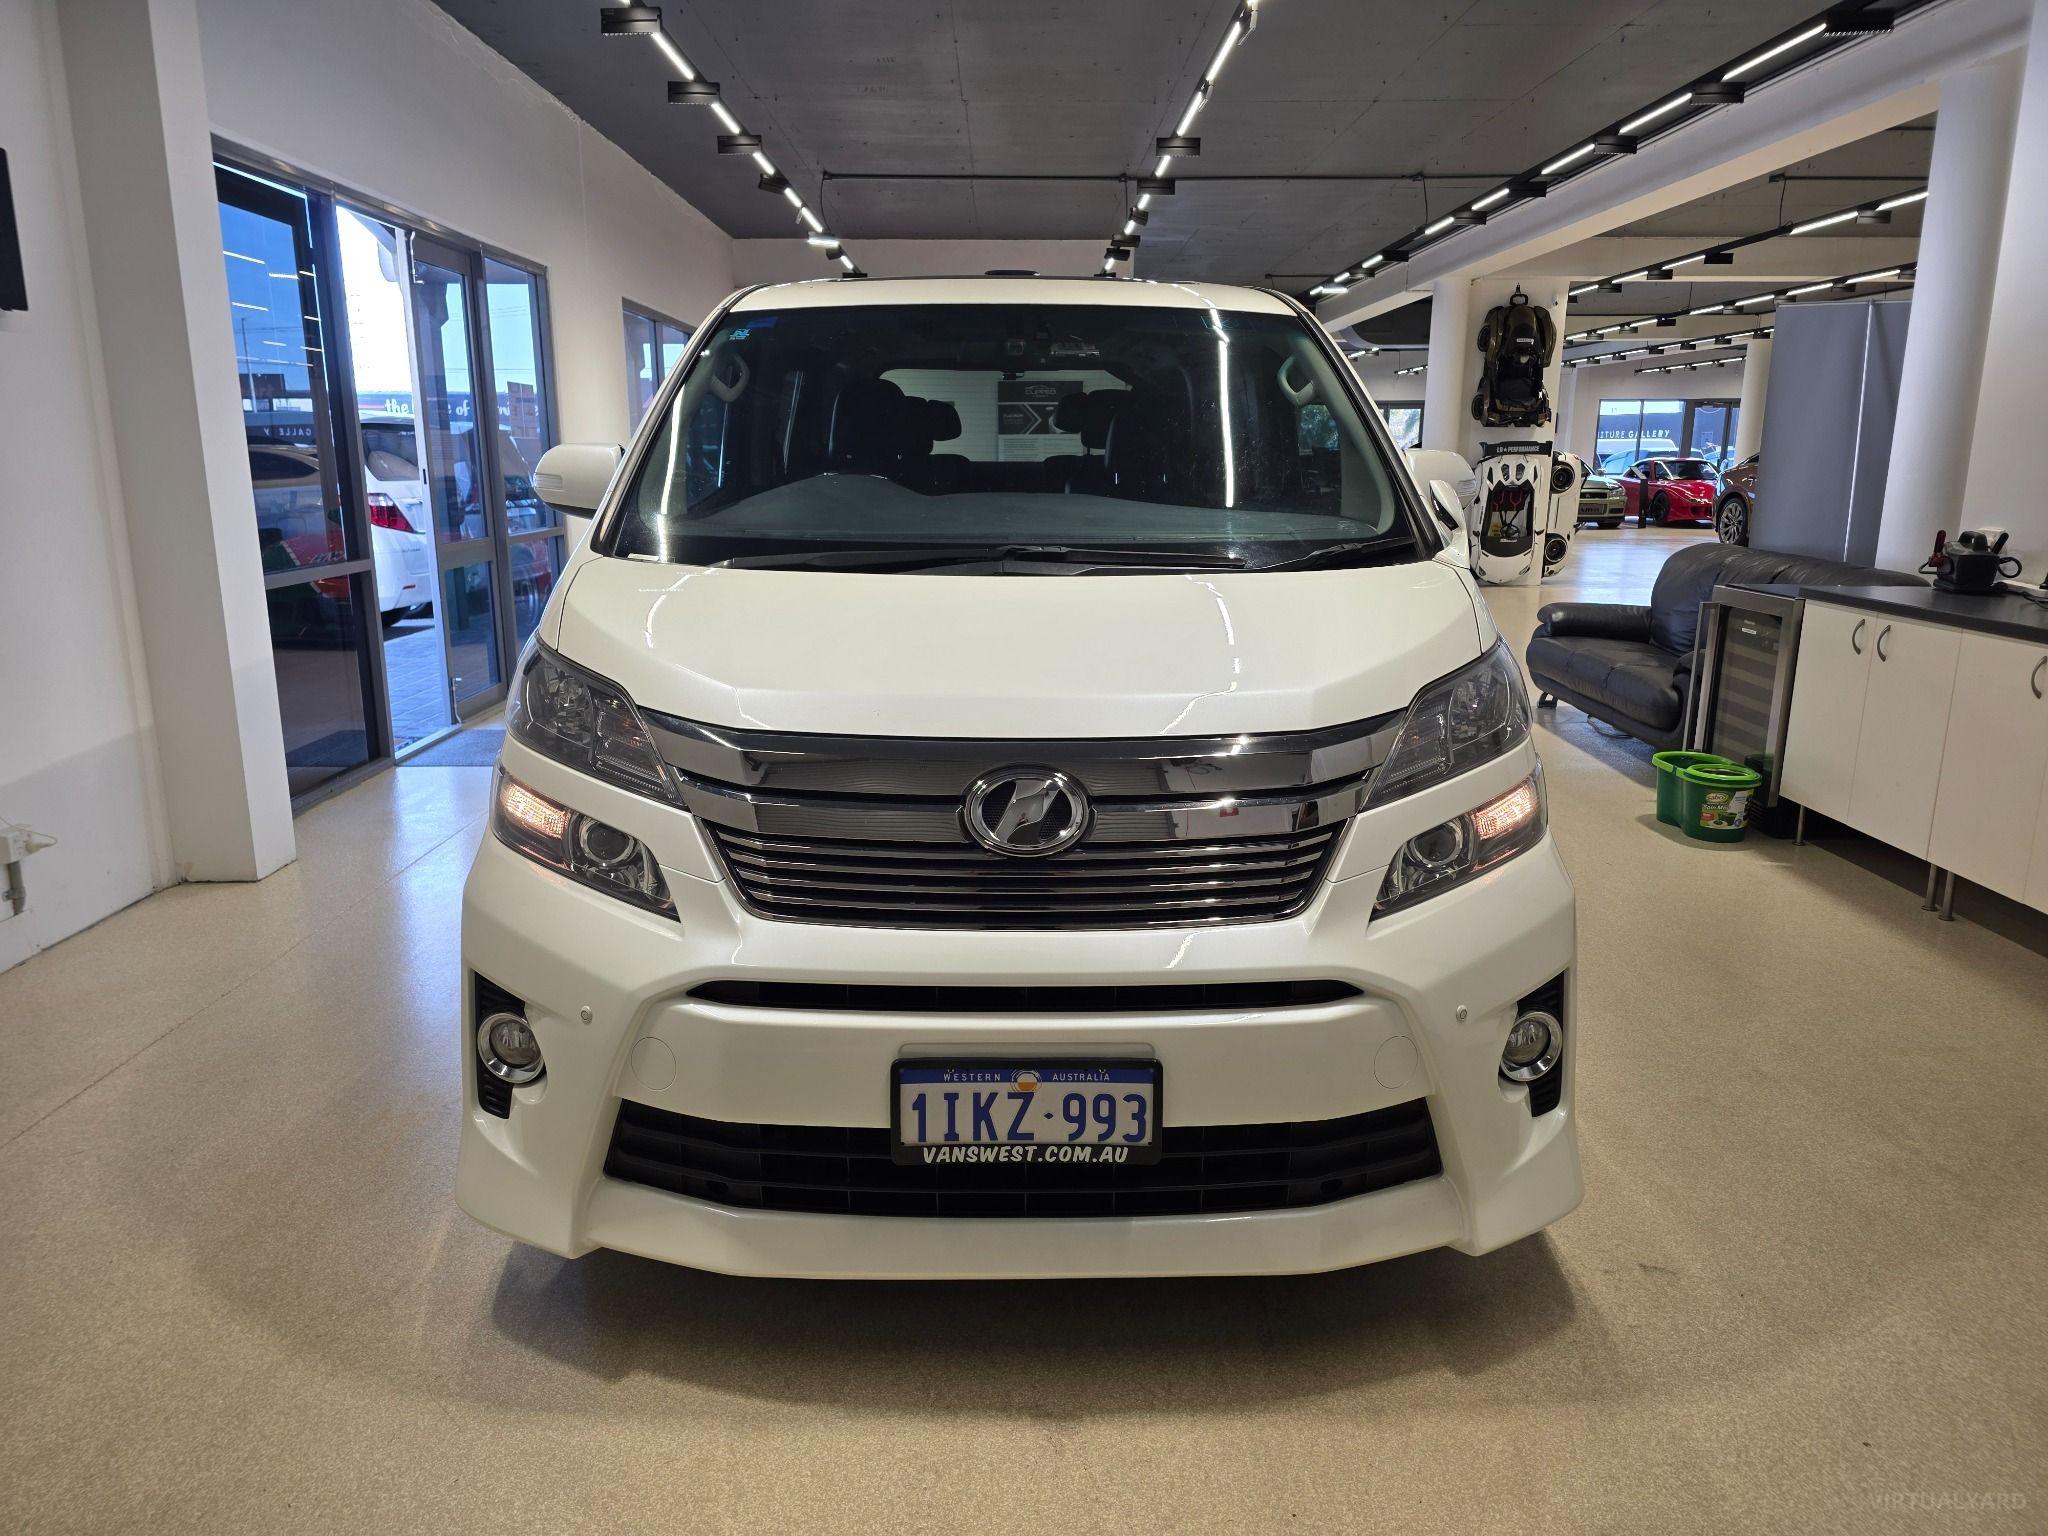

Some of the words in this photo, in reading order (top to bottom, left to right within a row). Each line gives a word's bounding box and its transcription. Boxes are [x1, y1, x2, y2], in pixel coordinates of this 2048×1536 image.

[1597, 430, 1626, 439] ITURE
[943, 1072, 1001, 1082] WESTERN
[1052, 1072, 1111, 1082] AUSTRALIA
[922, 1145, 1129, 1163] VANSWEST.COM.AU
